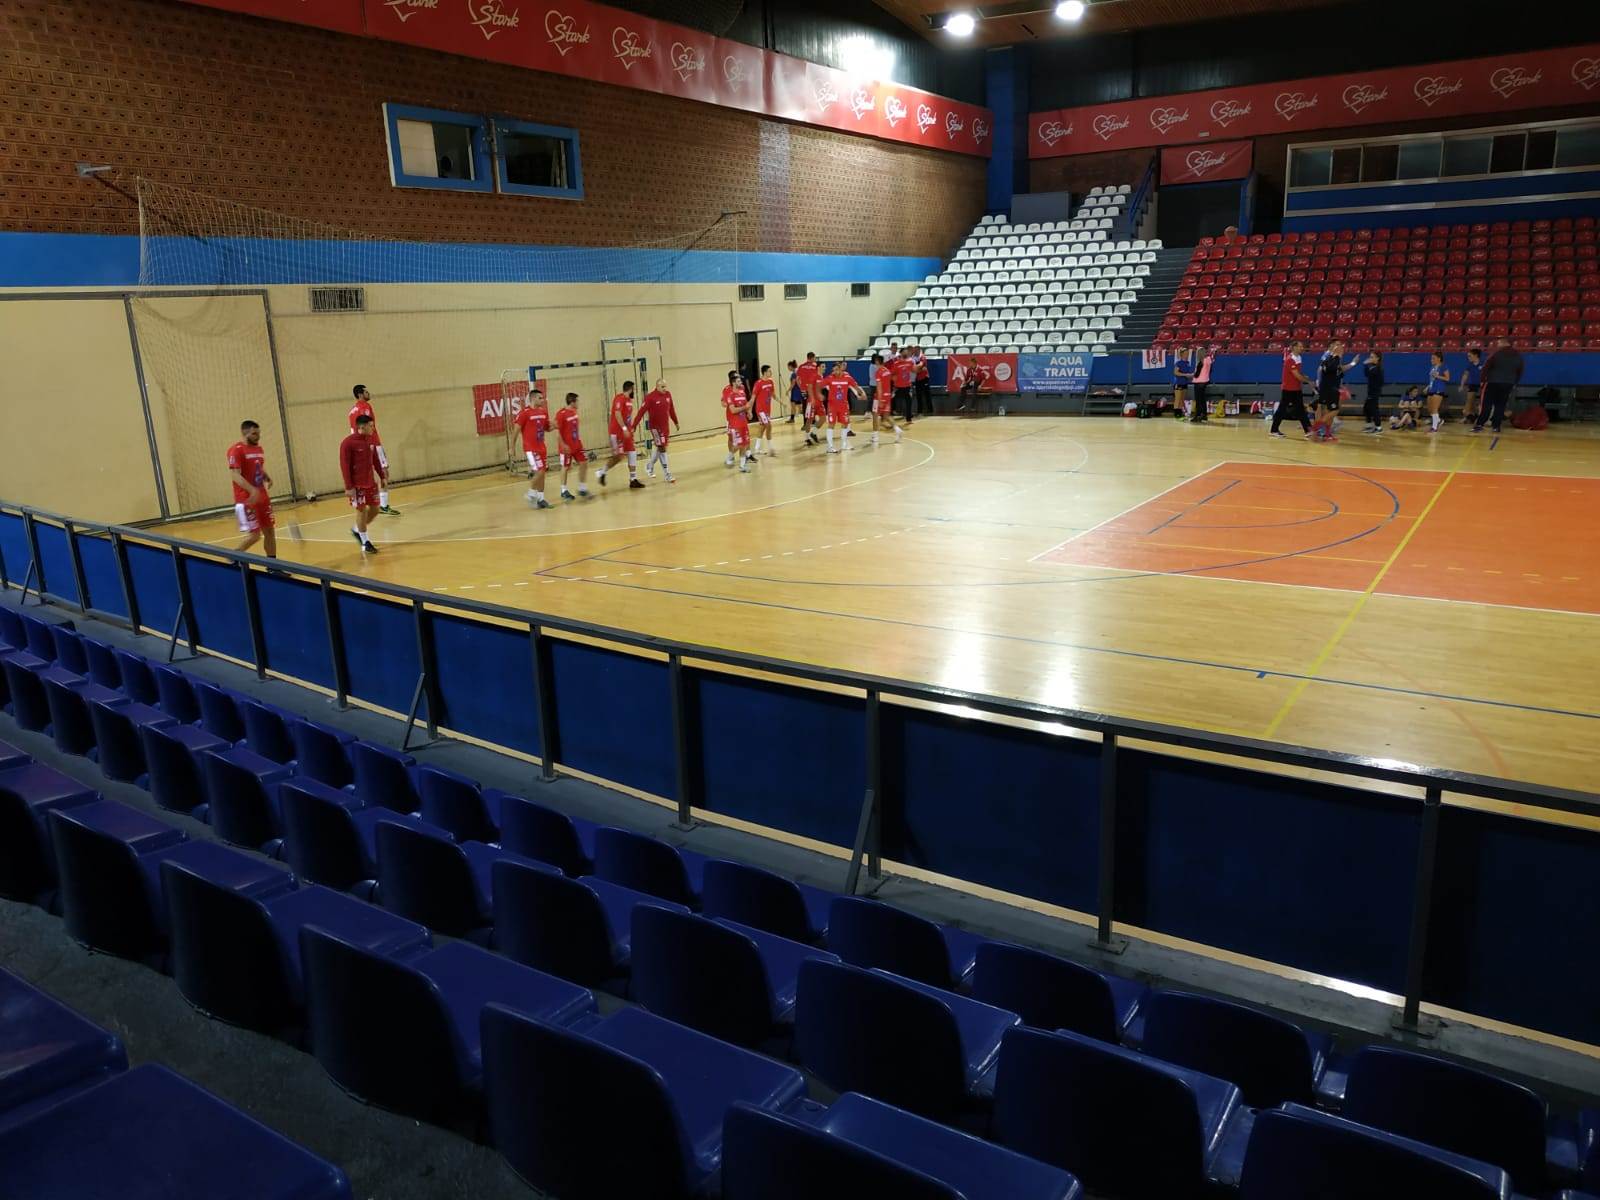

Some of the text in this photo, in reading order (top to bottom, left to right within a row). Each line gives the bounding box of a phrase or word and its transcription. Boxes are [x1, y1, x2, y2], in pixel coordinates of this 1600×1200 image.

[470, 5, 519, 28] Stark
[547, 23, 590, 44] Stark
[613, 39, 652, 58] Stark
[673, 53, 705, 71] Stark
[1416, 77, 1463, 100] Stark
[1491, 69, 1541, 92] Stark
[1276, 94, 1318, 113] Stark
[1344, 86, 1389, 108] Stark
[1152, 106, 1189, 129] Stark
[1212, 101, 1251, 121] Stark
[1040, 124, 1074, 142] Stark
[1094, 115, 1130, 132] Stark
[1189, 153, 1226, 171] Stark
[1050, 356, 1083, 366] AQUA
[1044, 367, 1088, 377] TRAVEL
